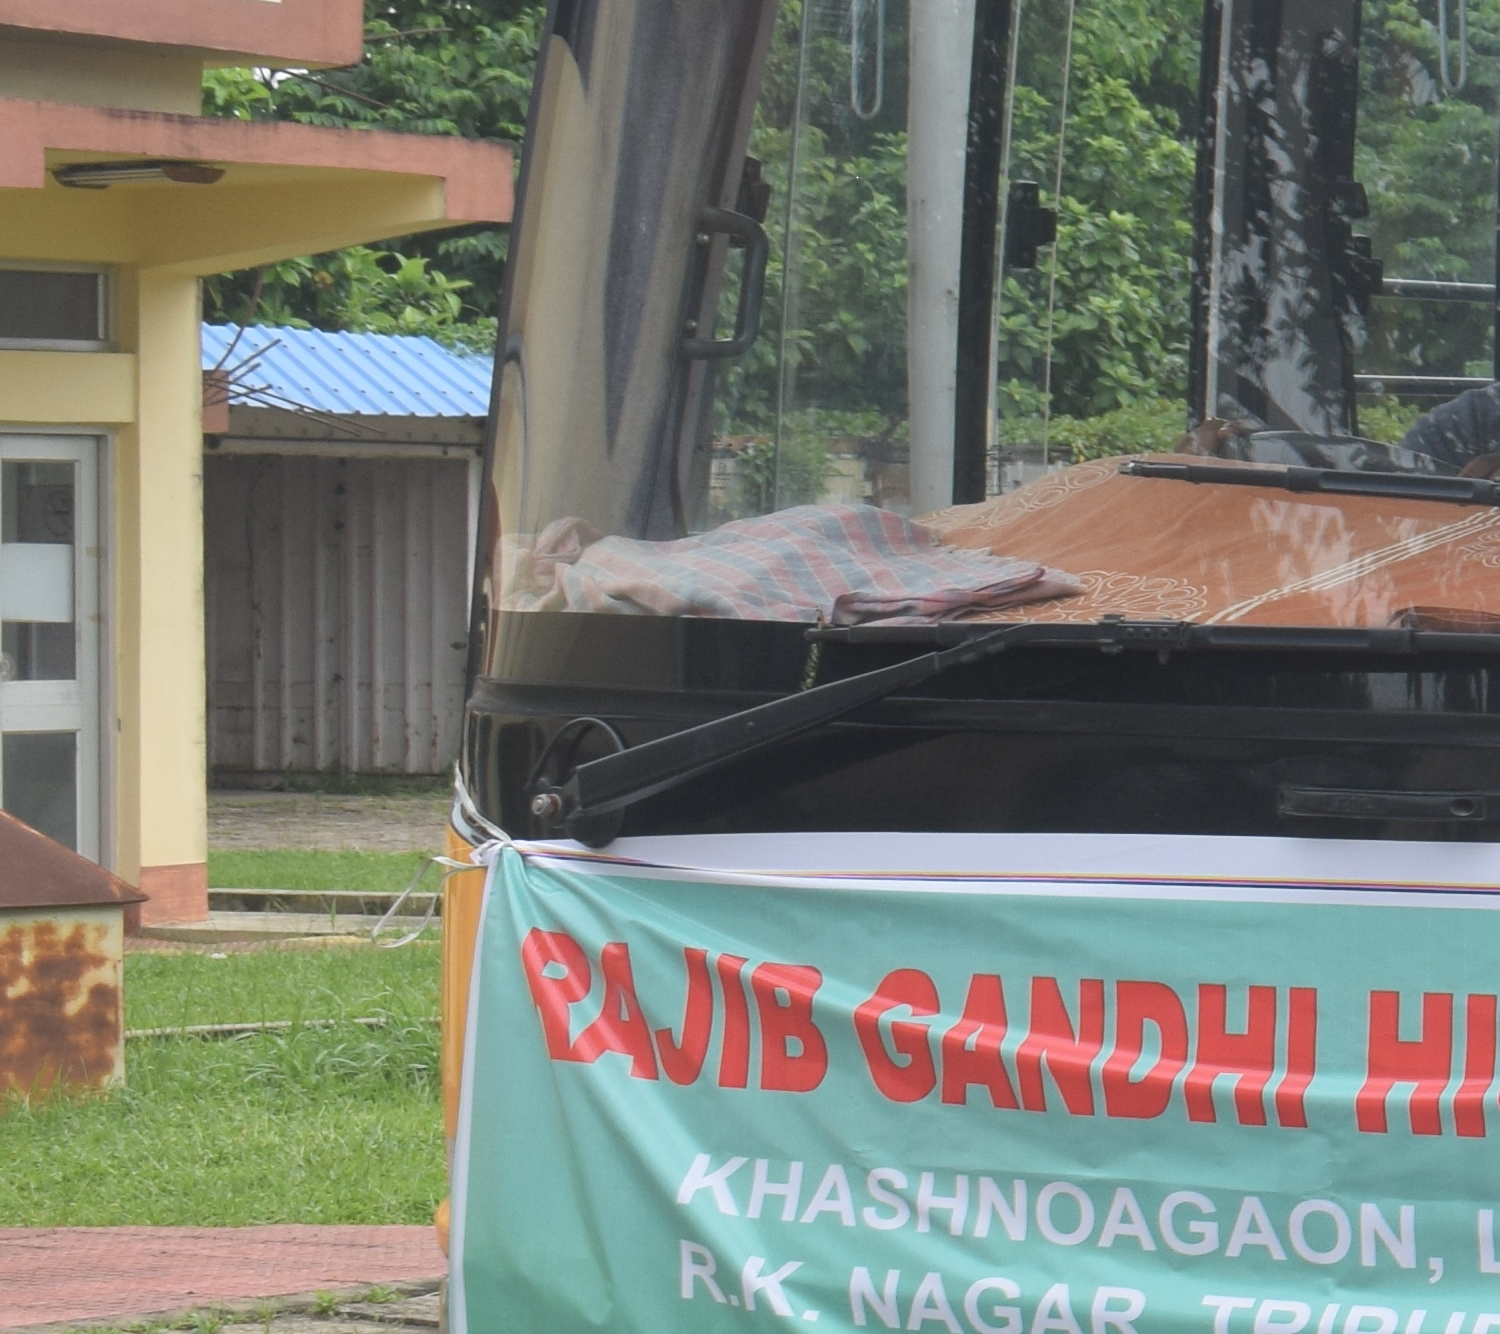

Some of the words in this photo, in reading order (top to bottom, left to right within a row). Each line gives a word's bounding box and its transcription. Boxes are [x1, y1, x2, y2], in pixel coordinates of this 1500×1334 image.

[519, 926, 829, 1093] RAJIB
[852, 968, 1318, 1129] GANDHI
[676, 1153, 1446, 1285] KHASHNOAGAON,
[679, 1238, 822, 1323] R.K.
